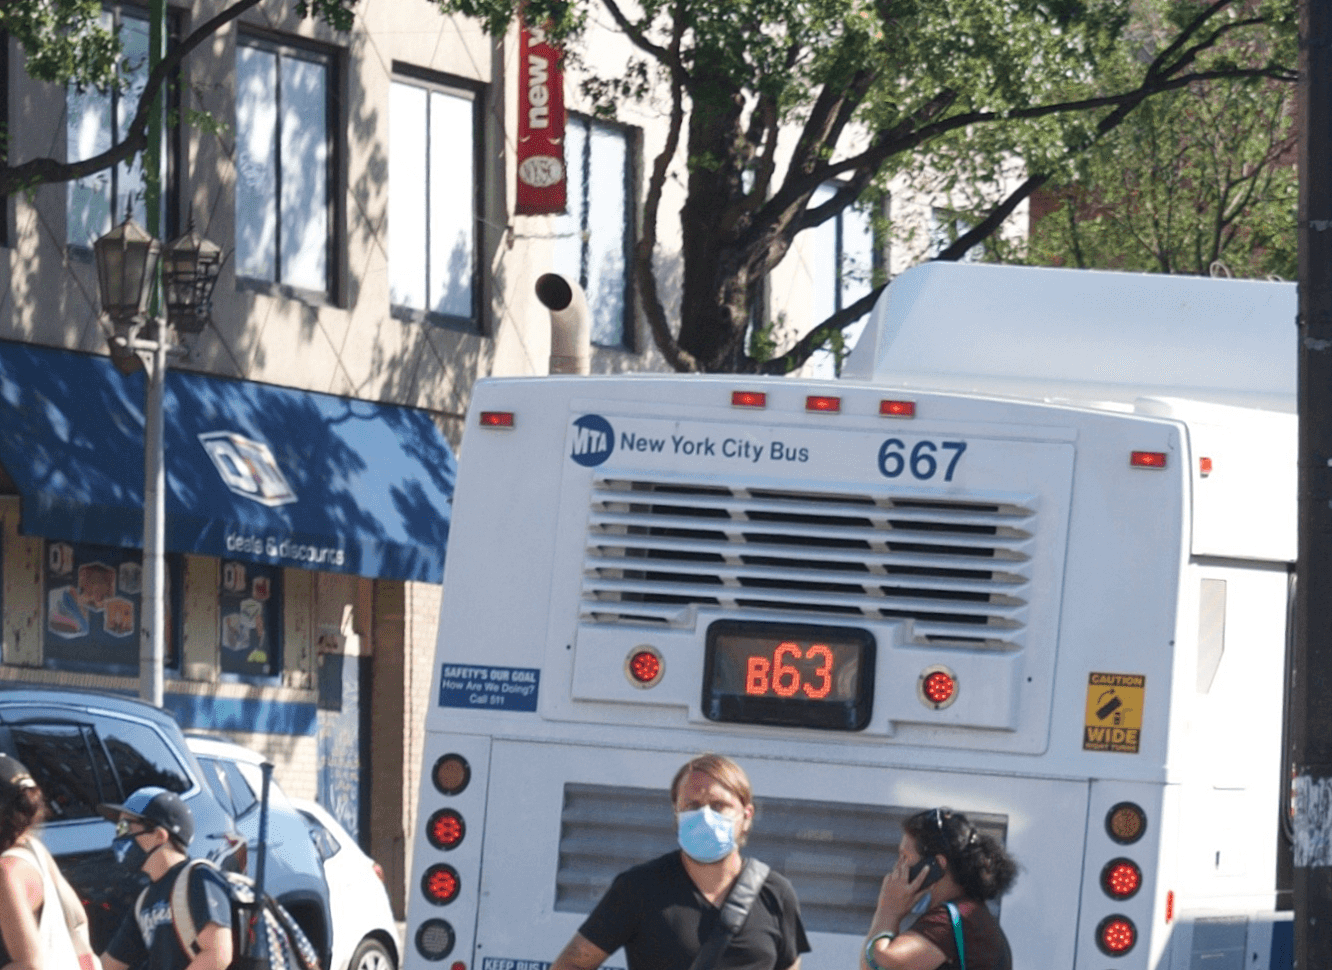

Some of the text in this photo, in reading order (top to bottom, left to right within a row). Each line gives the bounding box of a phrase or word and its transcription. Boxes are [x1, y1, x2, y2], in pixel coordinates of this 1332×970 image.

[528, 54, 550, 129] new
[620, 431, 666, 454] New
[671, 435, 716, 457] York
[721, 438, 764, 463] City
[769, 442, 810, 463] Bus
[877, 437, 968, 482] 667
[227, 532, 345, 566] deals & discounts
[444, 667, 536, 683] SAFETY'S OUR GOAL
[746, 641, 834, 699] B63
[442, 679, 536, 697] How Are We Doing?
[1091, 674, 1142, 685] CAUTION
[469, 693, 488, 705] Call
[1087, 728, 1137, 744] WIDE
